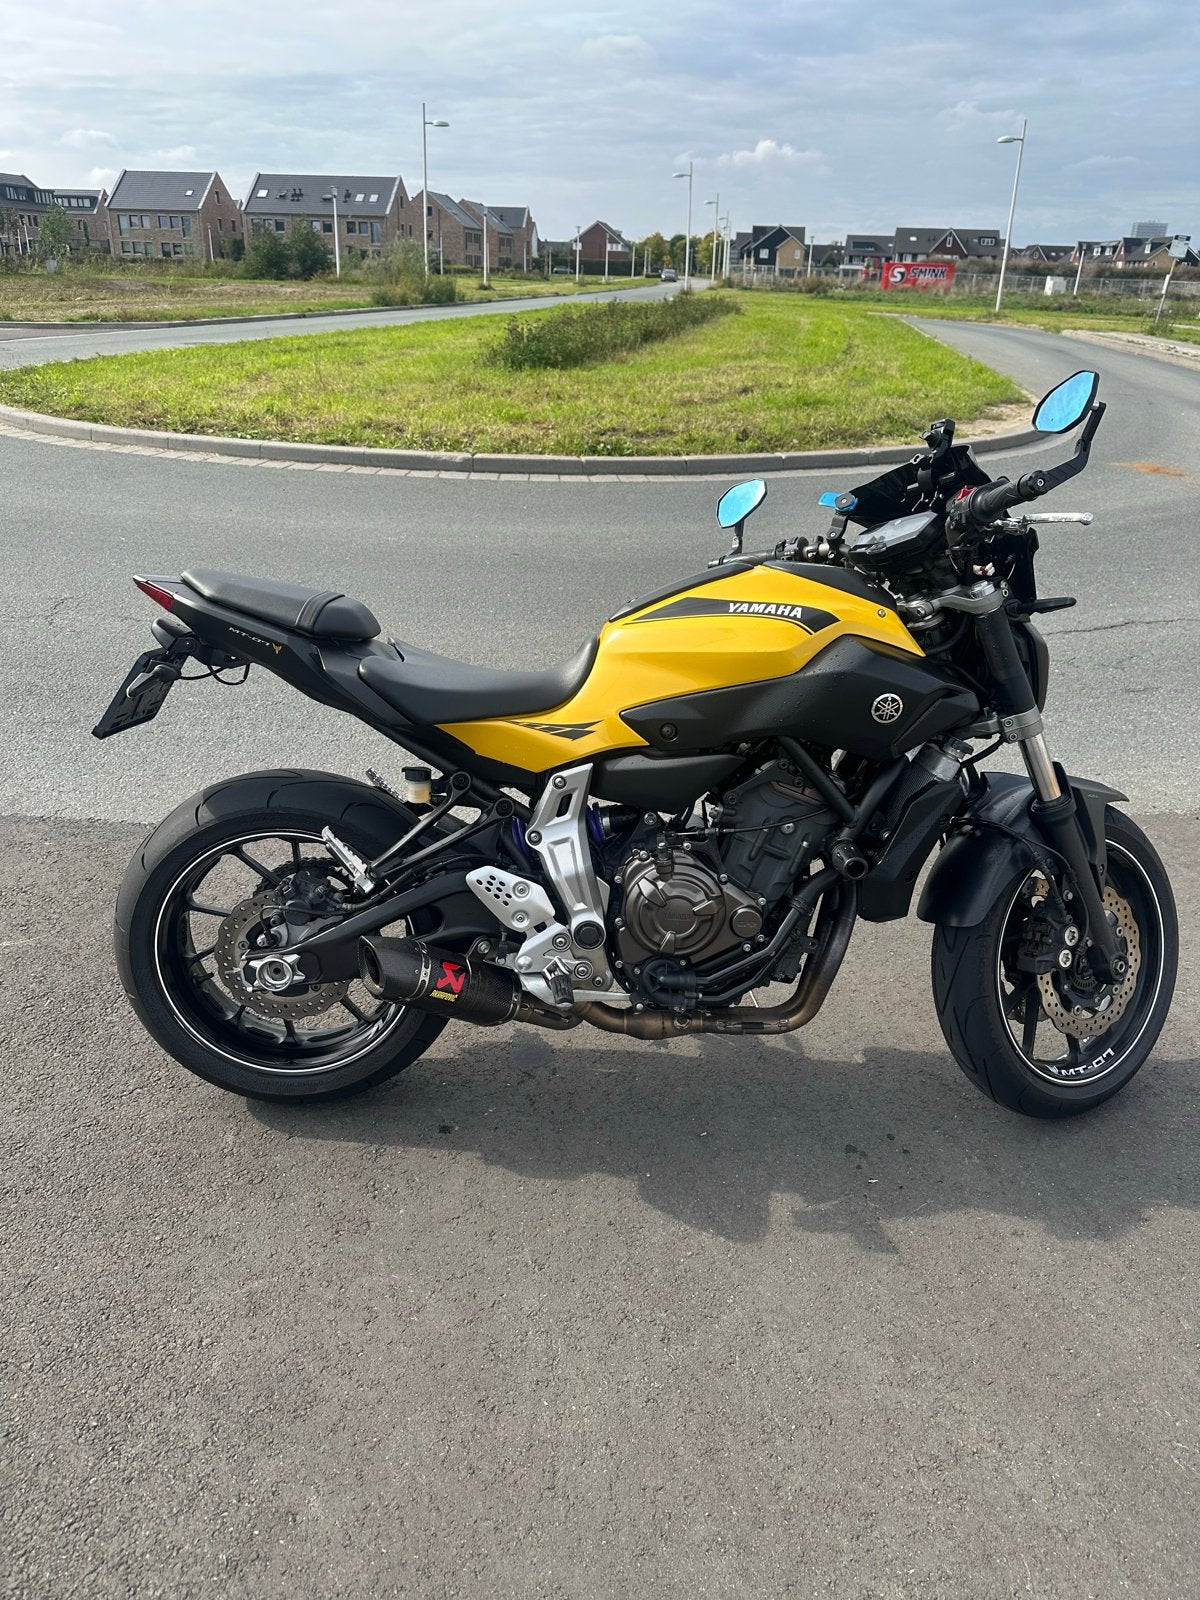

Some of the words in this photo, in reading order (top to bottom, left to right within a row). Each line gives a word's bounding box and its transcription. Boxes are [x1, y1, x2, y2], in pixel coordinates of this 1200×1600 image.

[909, 266, 949, 280] SMINK
[728, 602, 803, 619] YAMAHA
[1061, 1047, 1115, 1076] MT-07
